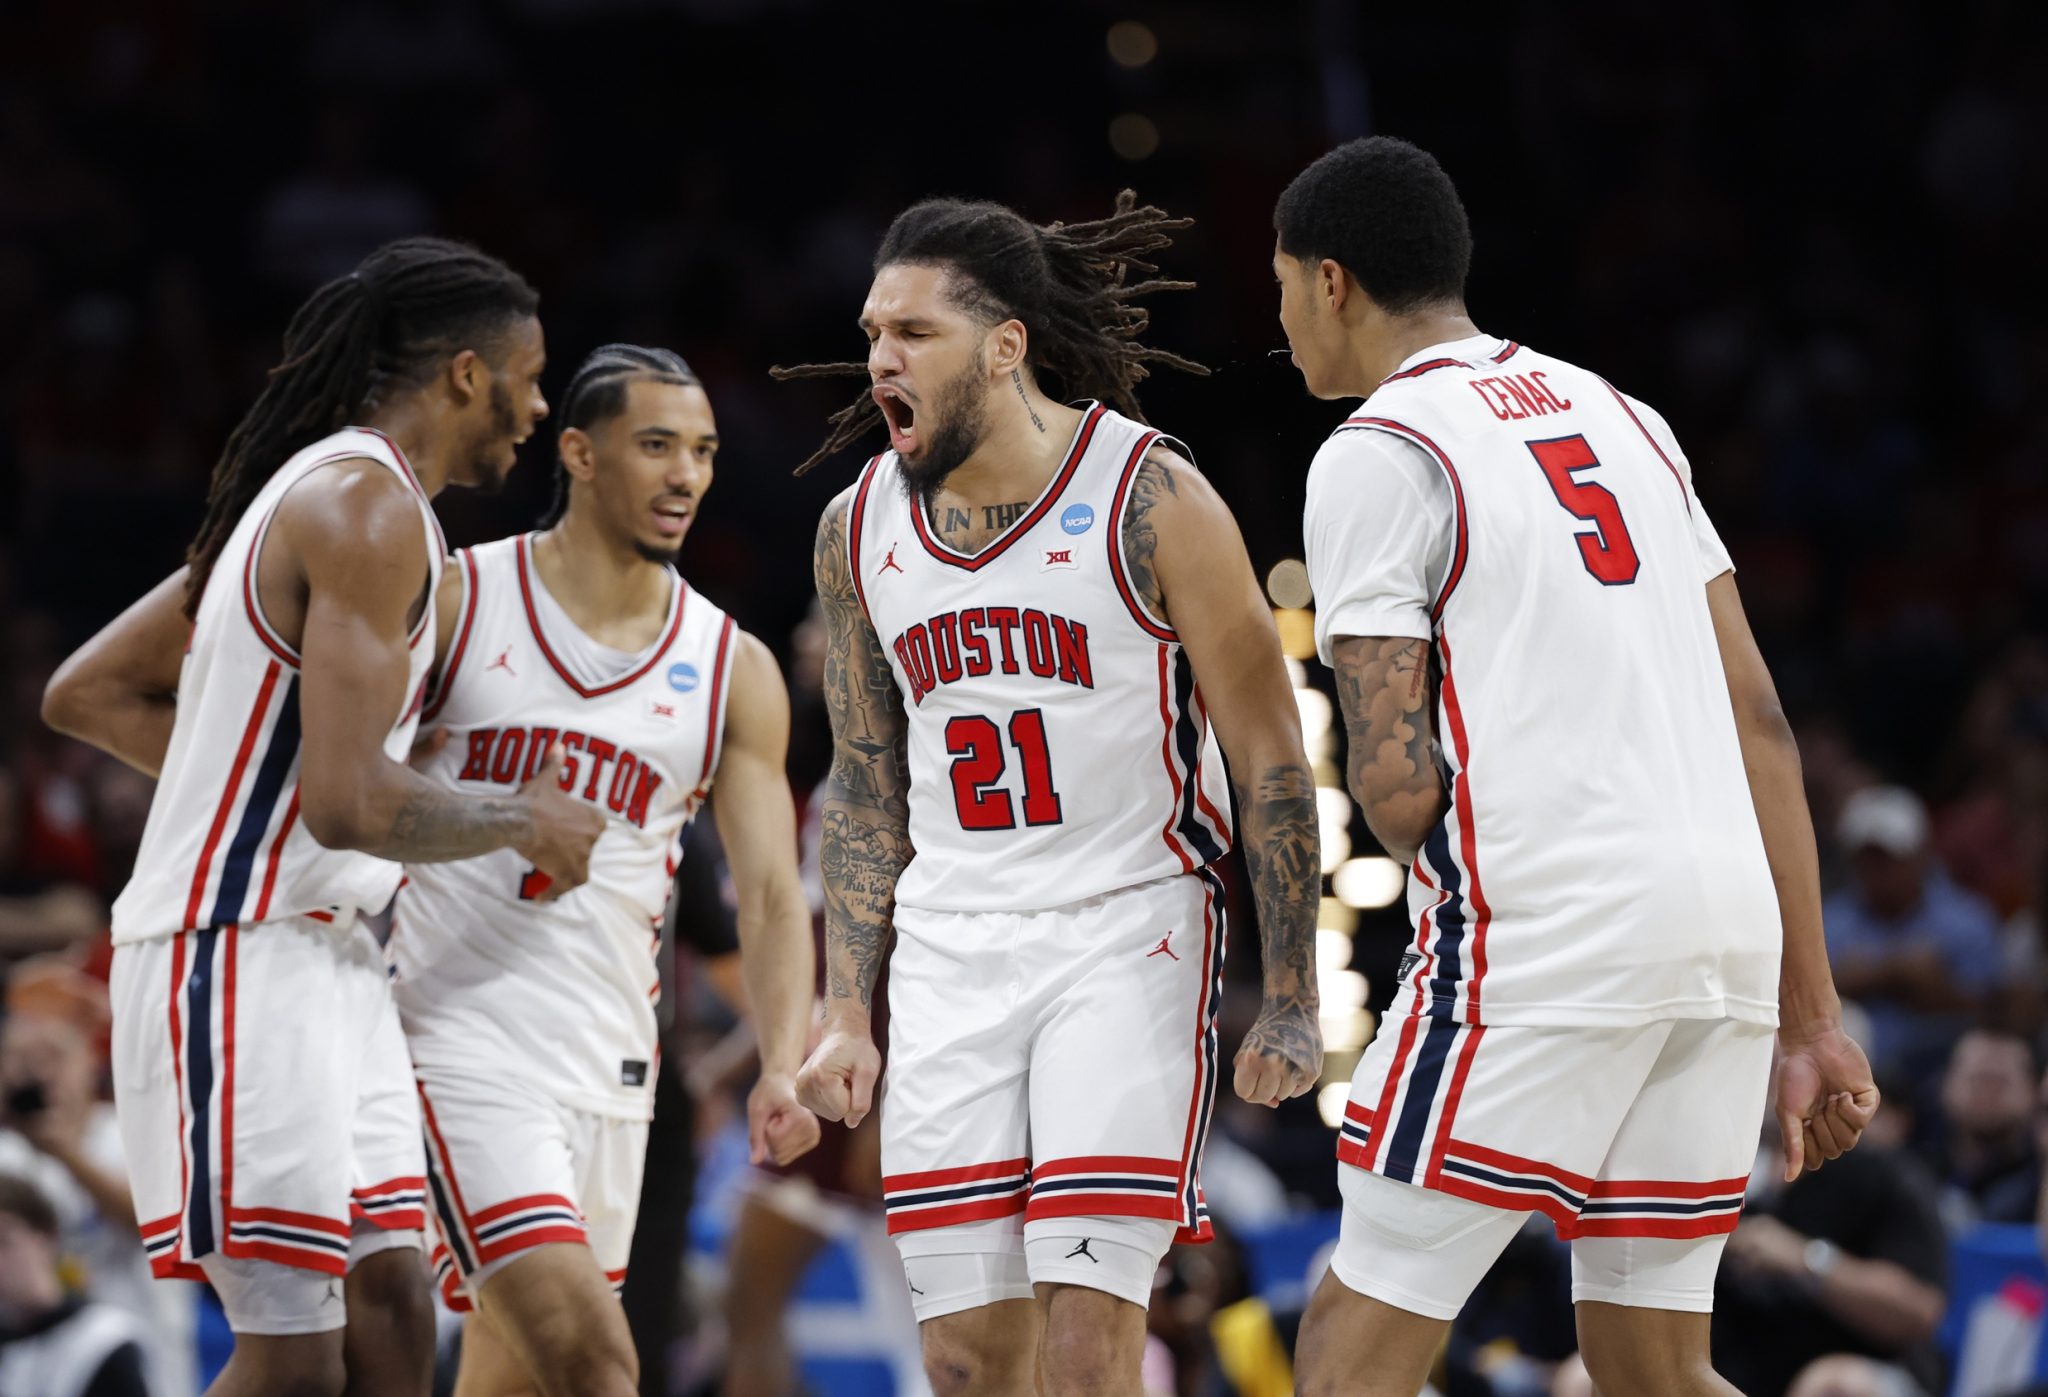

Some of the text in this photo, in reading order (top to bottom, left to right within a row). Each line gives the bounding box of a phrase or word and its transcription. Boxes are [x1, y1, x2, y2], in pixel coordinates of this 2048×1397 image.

[1468, 370, 1572, 421] CENAC
[944, 507, 972, 533] IN
[1064, 516, 1092, 528] NCAA
[1524, 432, 1641, 586] 5
[1046, 549, 1072, 565] XII
[893, 606, 1094, 707] HOUSTON
[458, 727, 664, 829] HOUSTON
[944, 707, 1063, 832] 21
[869, 880, 888, 897] too
